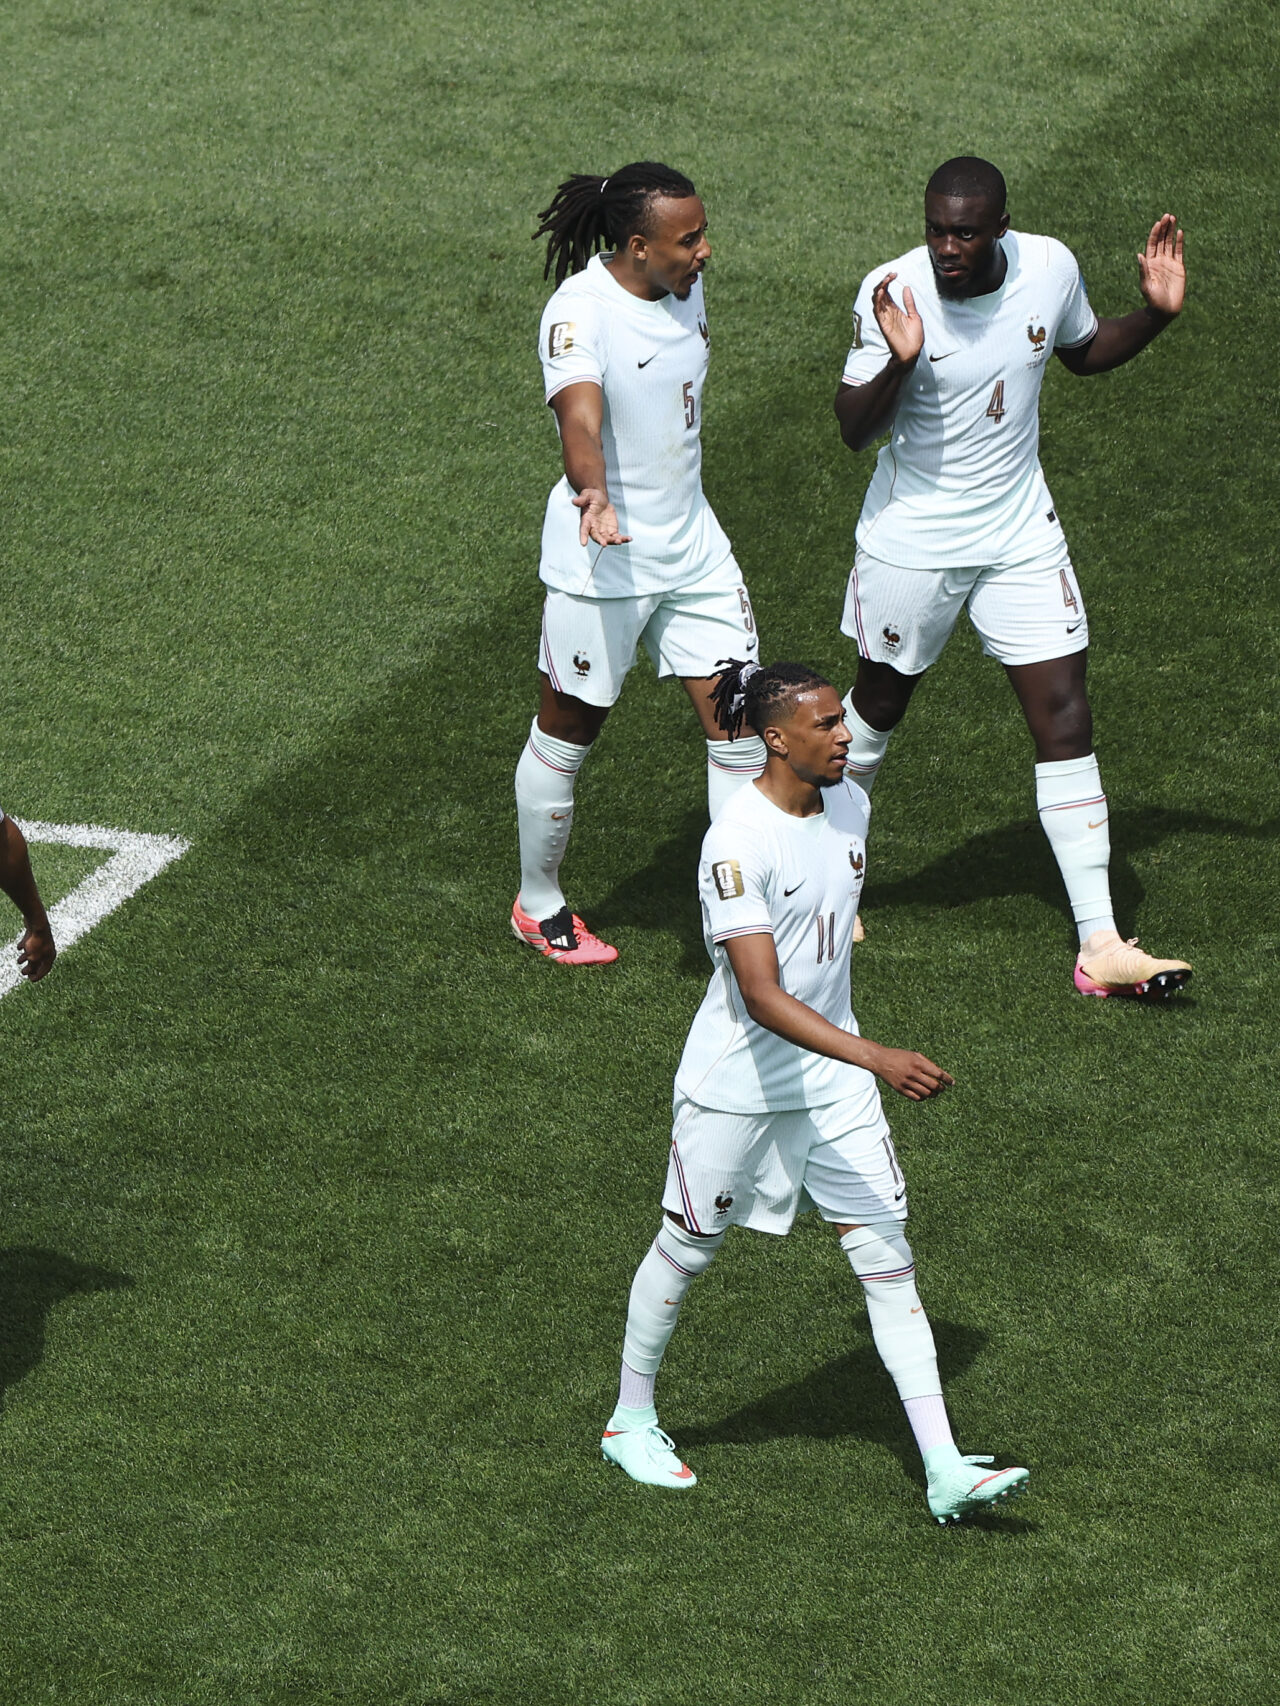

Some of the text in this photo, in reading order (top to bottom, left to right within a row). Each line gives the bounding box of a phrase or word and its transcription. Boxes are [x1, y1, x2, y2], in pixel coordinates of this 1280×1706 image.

[683, 381, 695, 428] 5
[986, 380, 1005, 424] 4
[737, 588, 753, 633] 5
[1060, 569, 1078, 614] 4
[817, 912, 835, 964] 11
